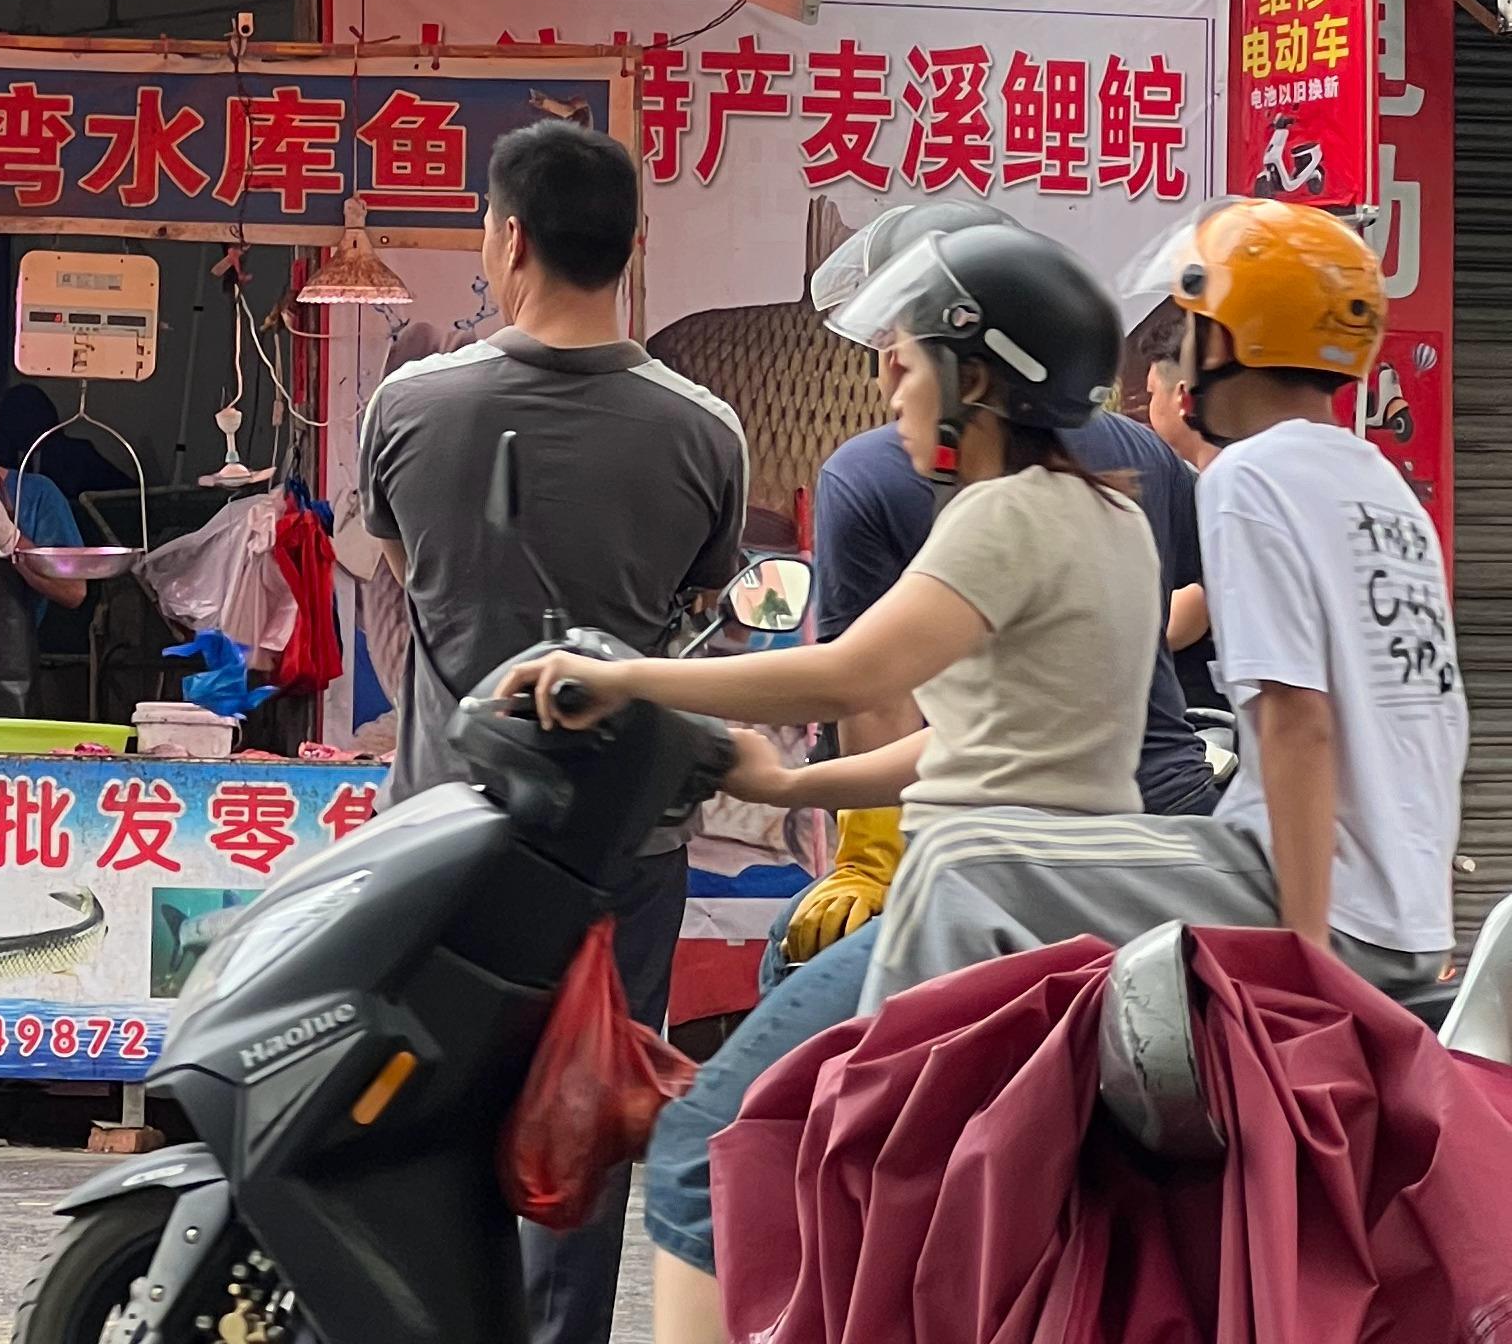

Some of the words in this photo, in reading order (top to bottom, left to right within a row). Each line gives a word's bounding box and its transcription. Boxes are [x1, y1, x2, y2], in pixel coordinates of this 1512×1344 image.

[1242, 13, 1350, 78] 电动车
[420, 22, 1189, 201] 特产麦溪鲤鲩
[1250, 75, 1340, 109] 电池以旧换新
